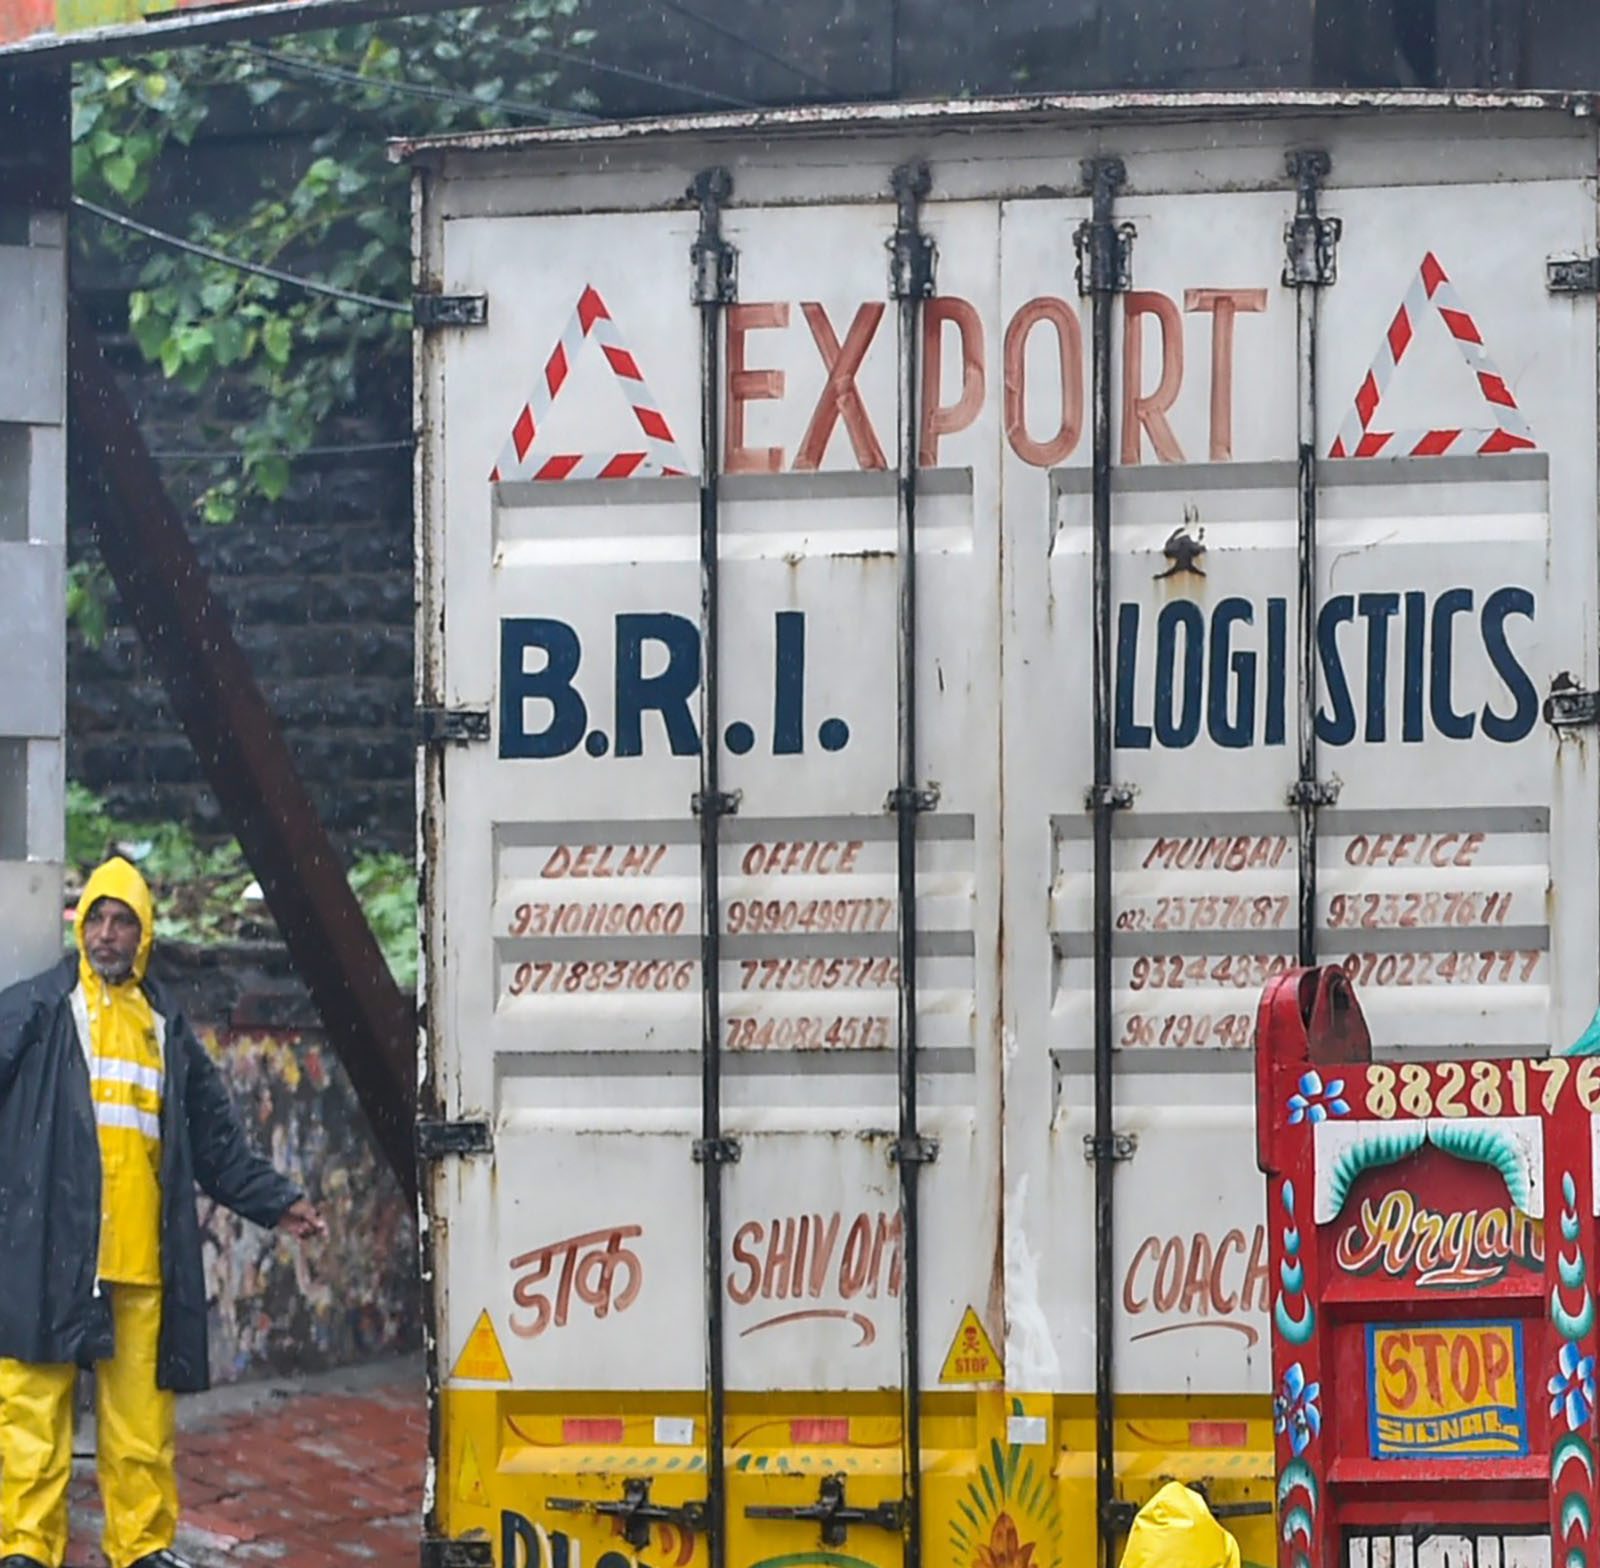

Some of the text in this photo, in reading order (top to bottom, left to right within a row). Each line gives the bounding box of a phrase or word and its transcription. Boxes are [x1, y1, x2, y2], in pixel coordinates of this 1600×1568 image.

[725, 288, 1267, 472] EXPORT
[498, 586, 1539, 760] B.R.I. LOGISTICS
[541, 841, 863, 879] DELHI OFFICE
[1143, 832, 1486, 871] MUMBAI OFFICE
[1123, 1224, 1269, 1316] COACH
[1337, 1190, 1545, 1287] Aryan
[955, 1356, 989, 1375] STOP
[1379, 1332, 1510, 1411] STOP
